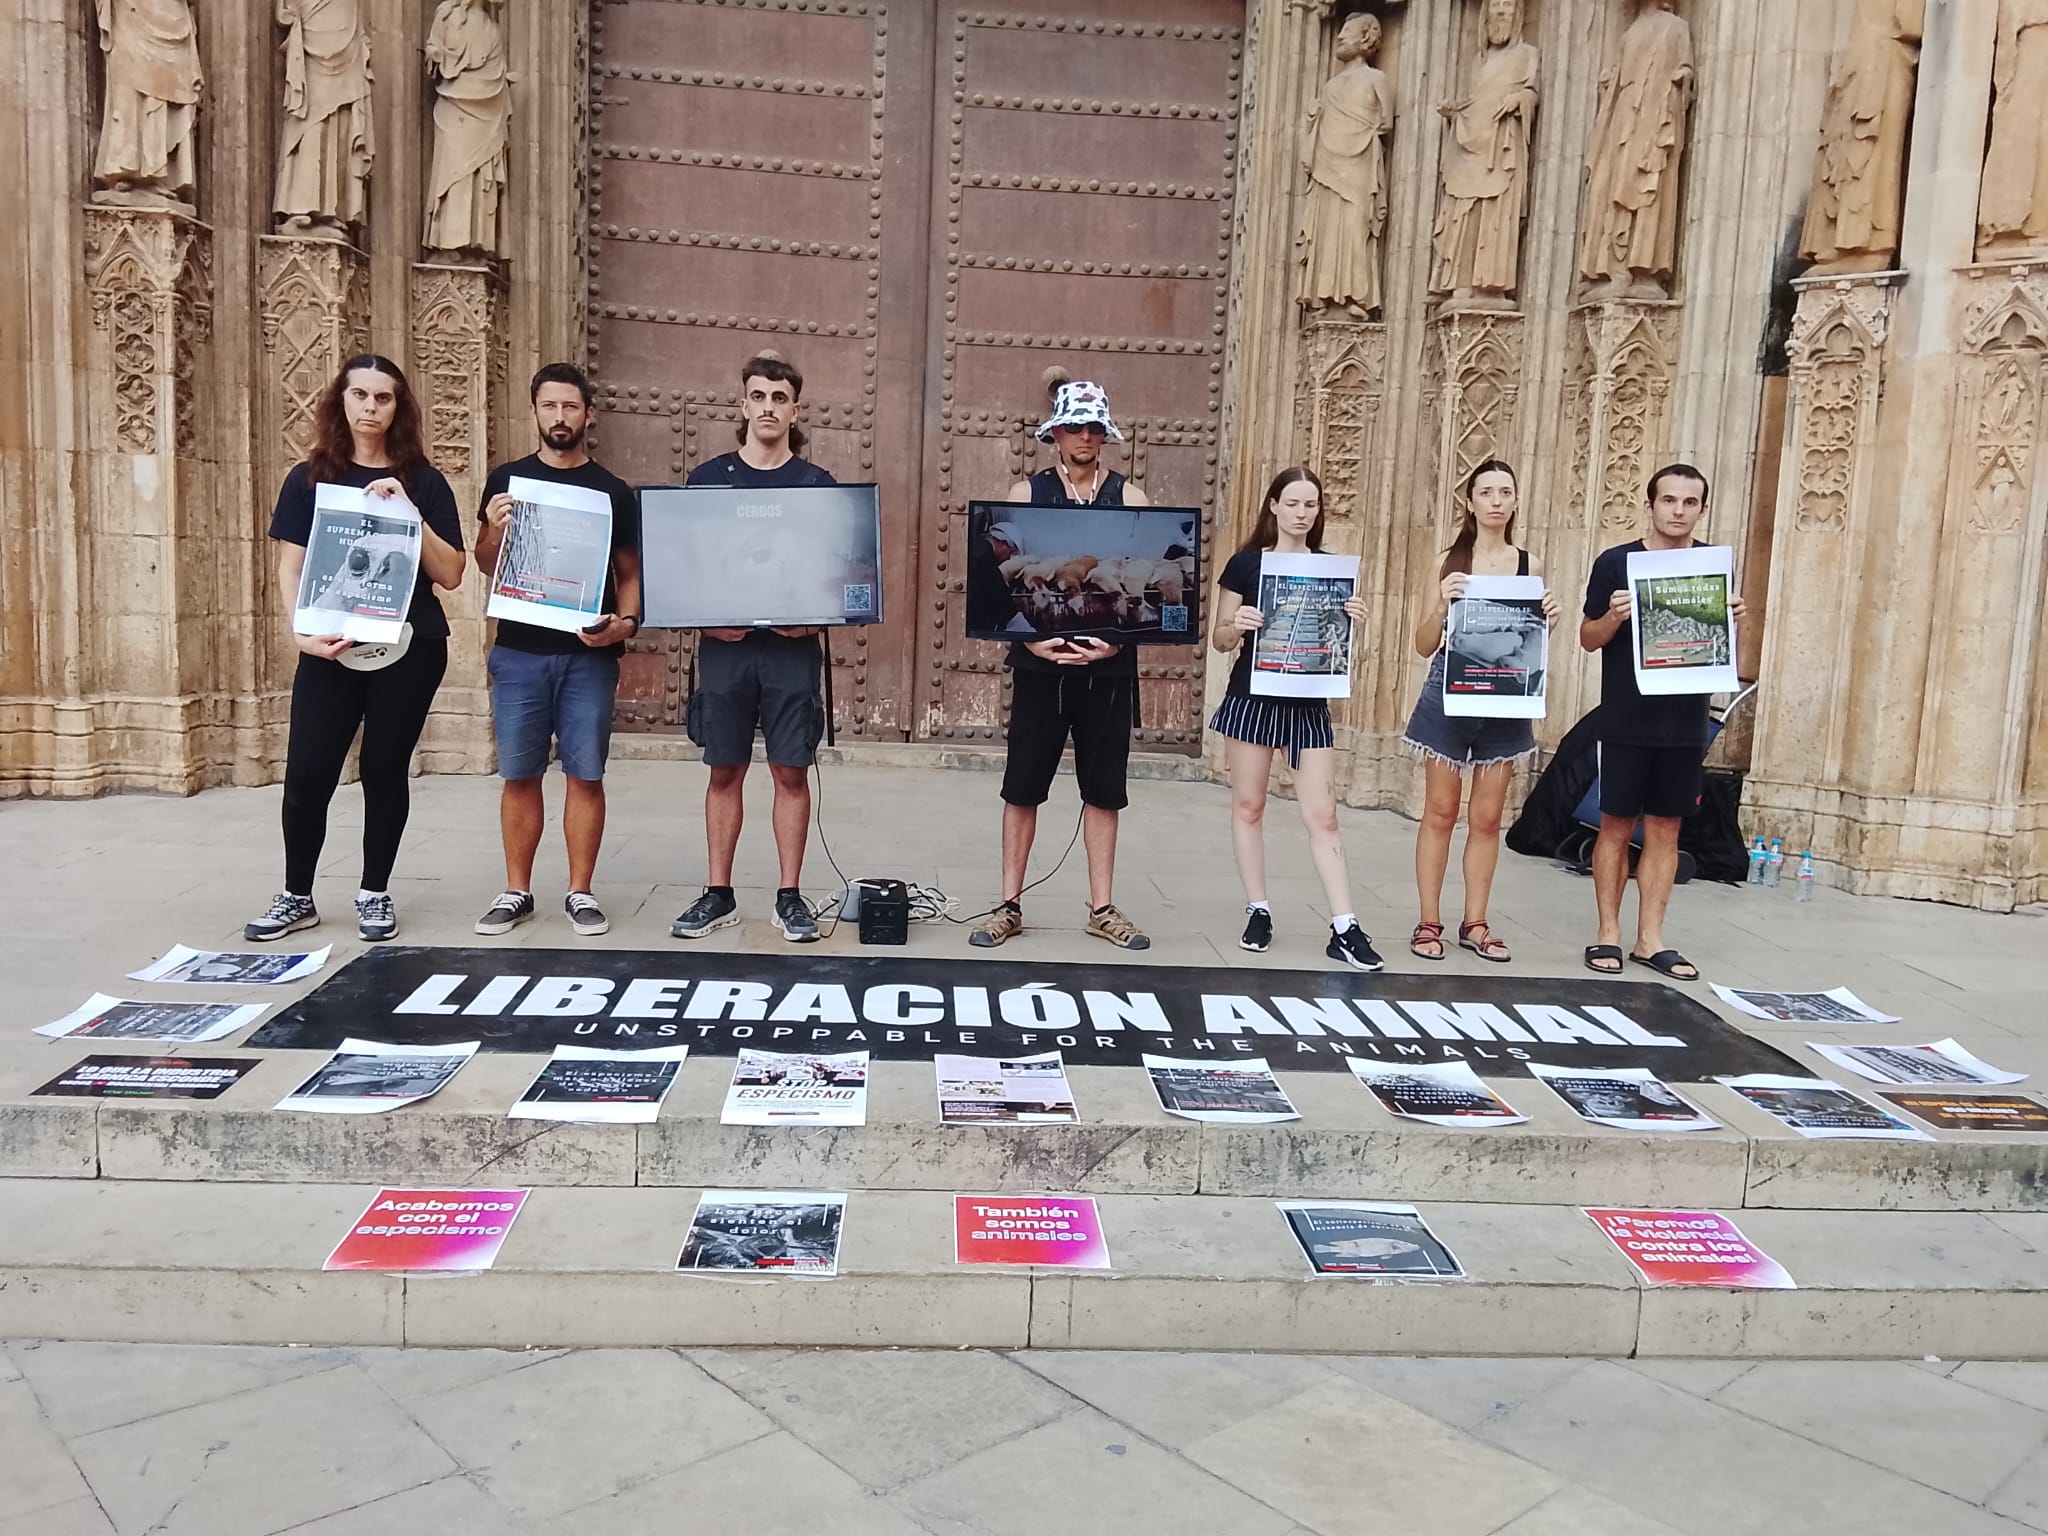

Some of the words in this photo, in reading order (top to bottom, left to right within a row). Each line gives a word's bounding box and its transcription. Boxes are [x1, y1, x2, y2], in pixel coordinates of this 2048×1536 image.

[392, 974, 1173, 1033] LIBERACIÓN
[1200, 994, 1688, 1047] ANIMAL
[573, 1022, 977, 1045] UNSTOPPABLE
[1021, 1033, 1116, 1048] FOR
[1156, 1037, 1253, 1052] THE
[1296, 1041, 1532, 1060] ANIMALS
[775, 1079, 828, 1089] STOP
[737, 1088, 856, 1100] ESPECISMO
[374, 1199, 515, 1211] Acabemos
[397, 1213, 447, 1223] con
[454, 1212, 480, 1223] el
[752, 1208, 803, 1219] peces
[972, 1205, 1079, 1218] También
[710, 1217, 778, 1225] sienten
[787, 1218, 802, 1226] el
[985, 1219, 1071, 1229] somos
[1605, 1216, 1720, 1230] ¡Paremos
[355, 1224, 504, 1237] especismo
[729, 1227, 780, 1235] dolor
[971, 1230, 1087, 1241] animales
[1606, 1226, 1632, 1238] la
[1635, 1228, 1740, 1242] violencia
[1626, 1240, 1706, 1252] contra
[1707, 1240, 1747, 1253] los
[1640, 1252, 1758, 1264] animales!
